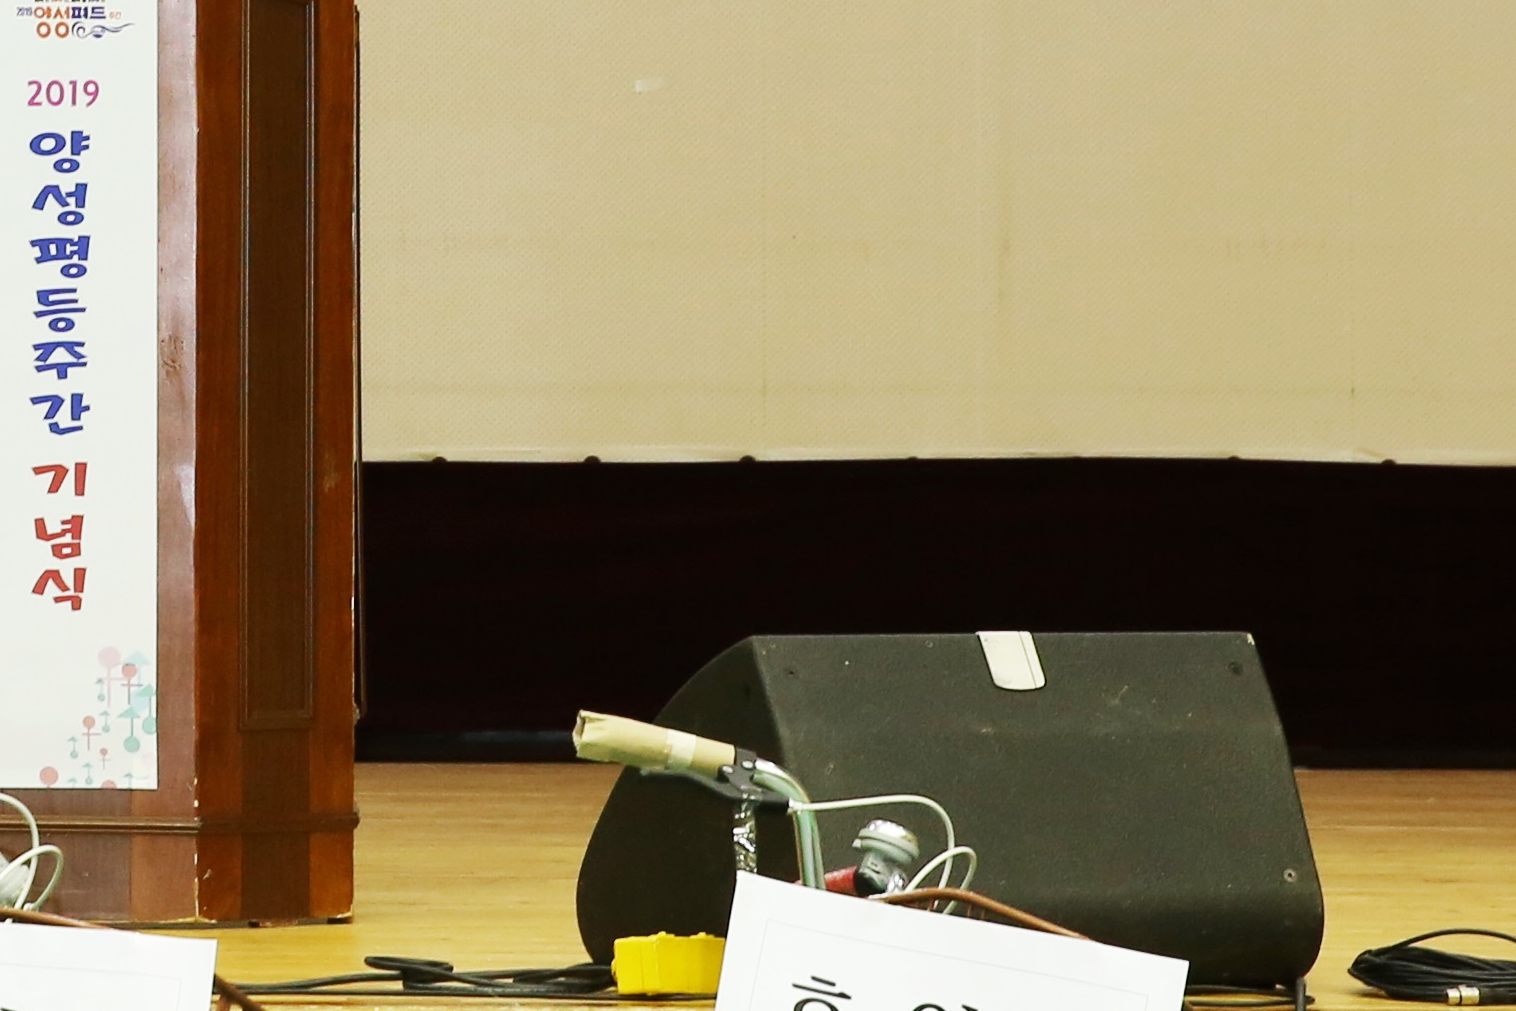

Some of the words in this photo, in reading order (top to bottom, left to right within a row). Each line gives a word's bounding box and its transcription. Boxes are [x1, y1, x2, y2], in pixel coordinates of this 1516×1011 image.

[27, 79, 100, 108] 2019
[29, 130, 91, 436] 양성평등주간
[31, 462, 88, 611] 기념식
